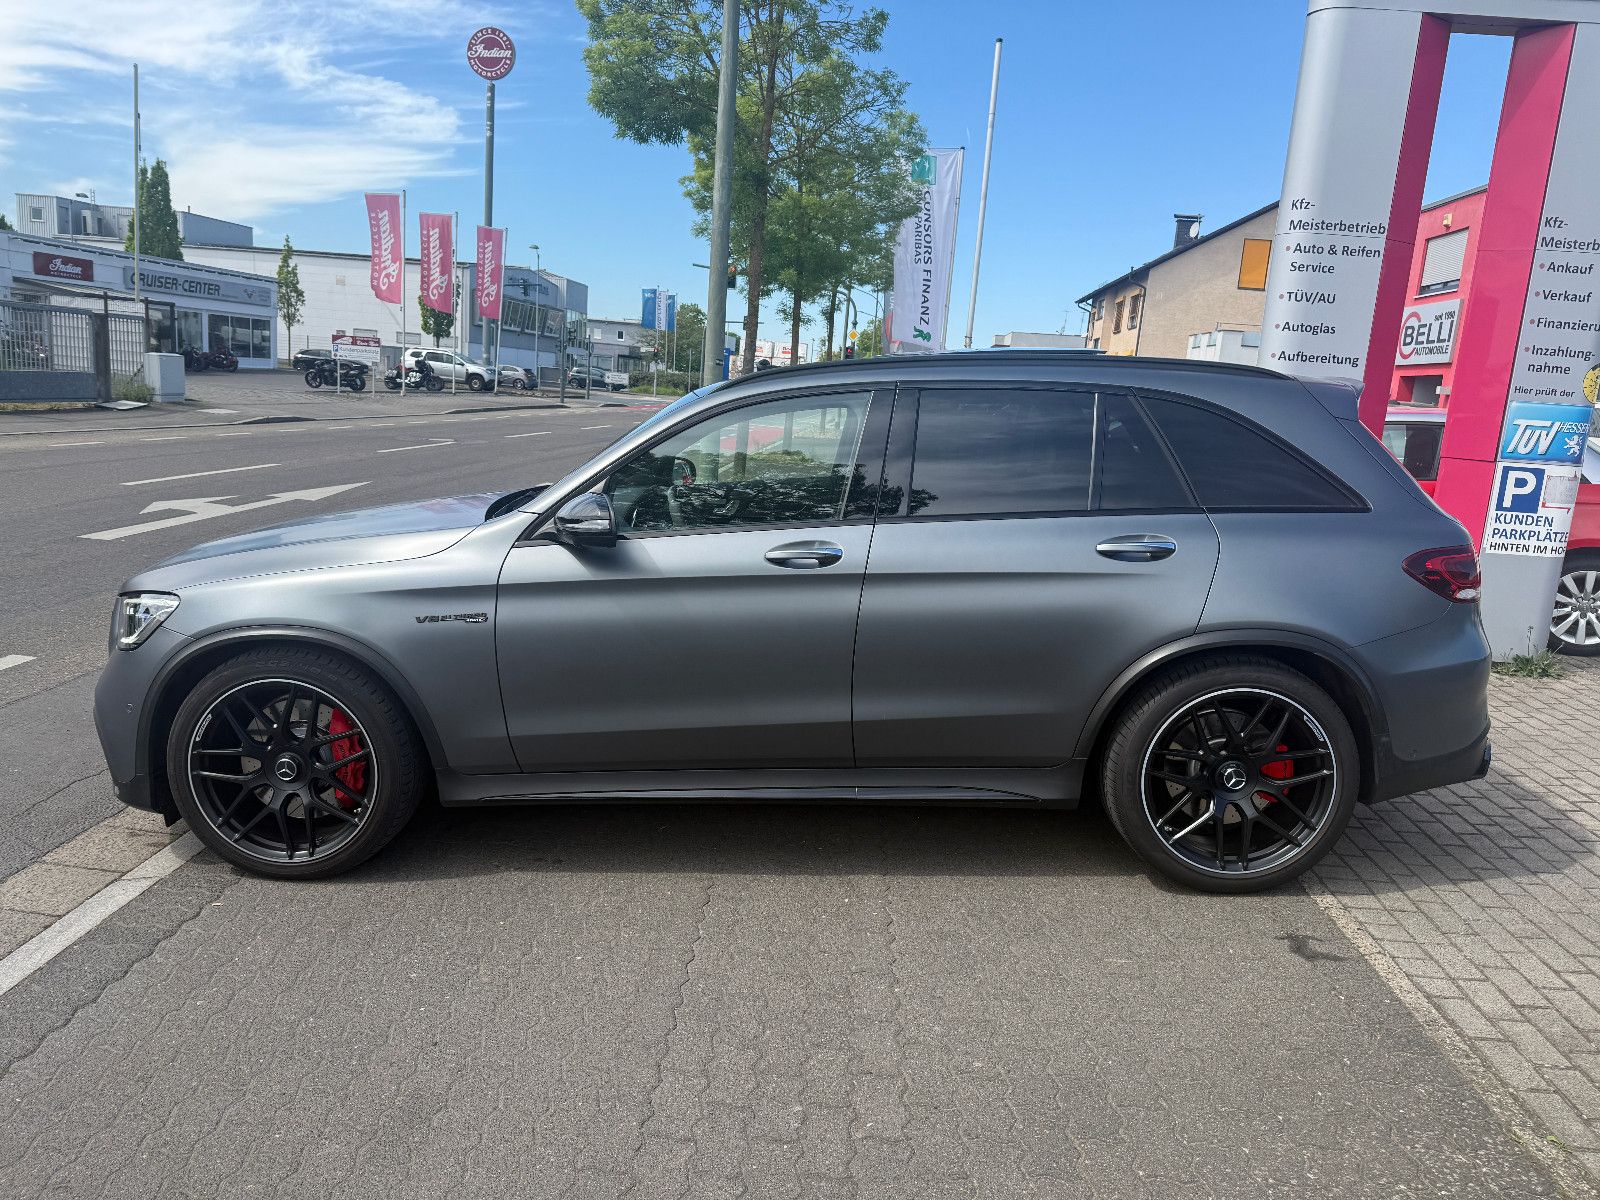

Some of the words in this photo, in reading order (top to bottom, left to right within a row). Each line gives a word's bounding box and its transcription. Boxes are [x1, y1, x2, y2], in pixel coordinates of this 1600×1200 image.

[468, 44, 512, 58] Indian
[470, 59, 511, 77] MOTORCYCLE
[1291, 198, 1316, 211] Kfz-
[923, 190, 933, 265] CONSORS
[1288, 218, 1387, 235] Meisterbetrieb
[1544, 216, 1569, 229] Kfz-
[914, 216, 923, 265] PARIBAS
[1540, 236, 1600, 251] Meisterb
[1292, 242, 1325, 255] Auto
[1327, 244, 1338, 256] &
[1341, 246, 1381, 258] Reifen
[49, 258, 82, 274] Indian
[1289, 261, 1336, 274] Service
[1546, 262, 1595, 275] Ankauf
[919, 269, 932, 326] FINANZ
[1286, 288, 1337, 305] TÜV/AU
[1542, 289, 1593, 303] Verkauf
[1281, 321, 1337, 336] Autoglas
[1536, 317, 1600, 332] Finanzieru
[1402, 320, 1455, 347] BELLI
[1414, 345, 1450, 356] AUTOMOBILE
[1531, 344, 1596, 362] Inzahlung-
[1277, 350, 1360, 368] Aufbereitung
[1527, 362, 1572, 375] nahme
[1514, 385, 1533, 395] Hier
[1534, 387, 1558, 397] prüft
[1559, 389, 1576, 398] der
[1502, 470, 1537, 508] P
[1494, 512, 1554, 528] KUNDEN
[1489, 542, 1530, 553] HINTEN
[1532, 545, 1548, 554] IM
[415, 616, 440, 624] V8
